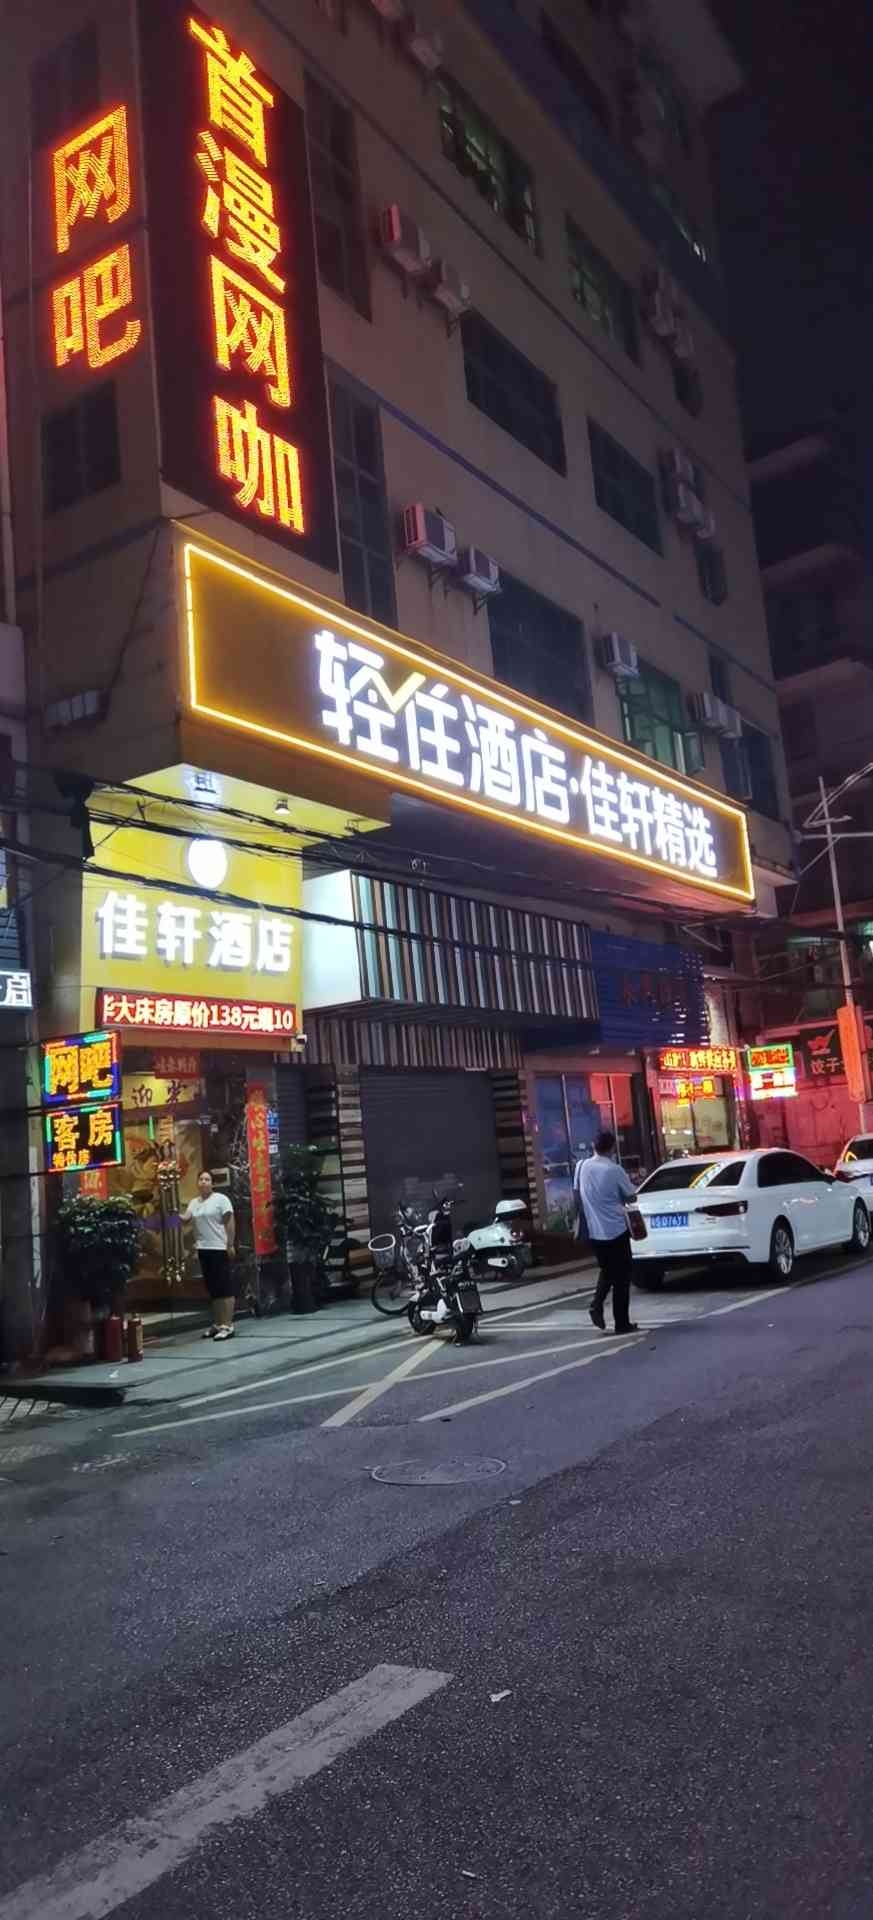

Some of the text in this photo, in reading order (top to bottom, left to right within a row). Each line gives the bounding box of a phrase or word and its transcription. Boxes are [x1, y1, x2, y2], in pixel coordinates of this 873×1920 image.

[52, 104, 141, 368] 网吧
[188, 18, 305, 535] 首漫网咖
[96, 890, 294, 975] 佳轩酒店
[48, 1042, 114, 1095] 网吧
[54, 1110, 114, 1151] 客房
